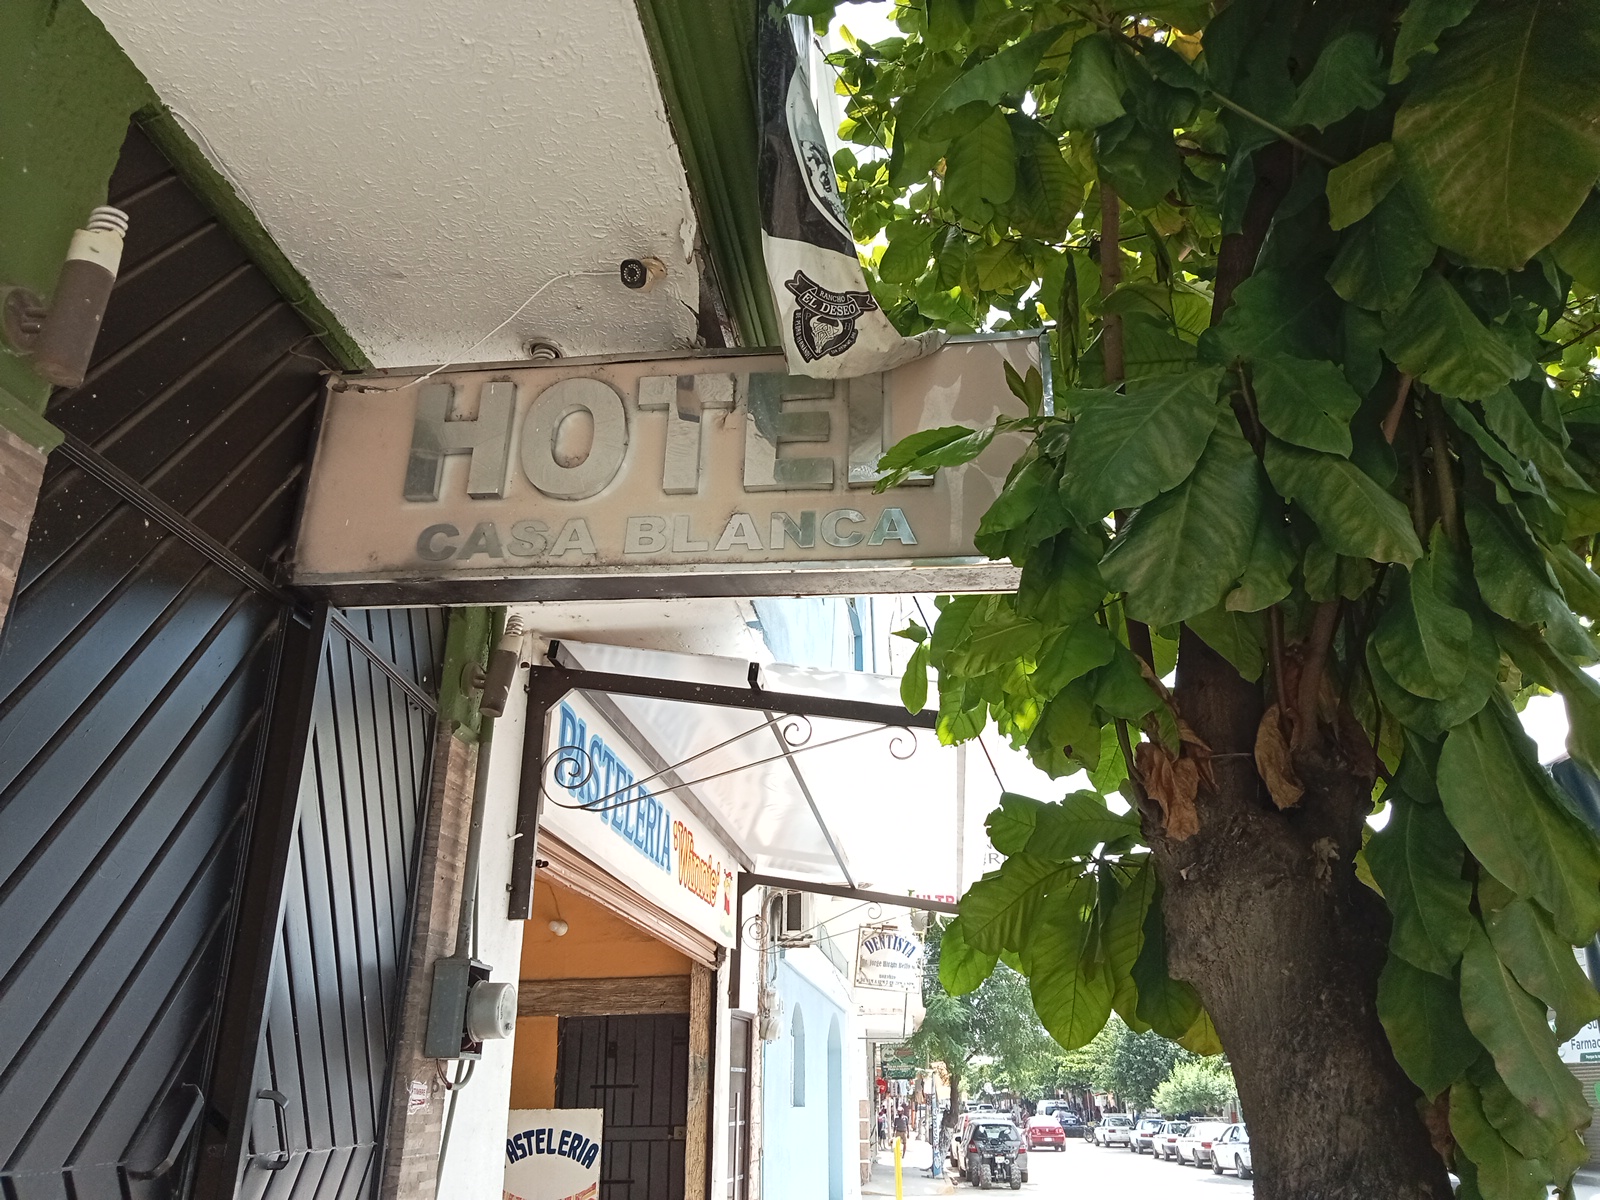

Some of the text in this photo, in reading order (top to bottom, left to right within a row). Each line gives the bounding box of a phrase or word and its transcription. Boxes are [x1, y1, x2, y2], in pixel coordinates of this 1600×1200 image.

[801, 293, 856, 317] EL DESEO
[820, 290, 845, 303] RANCHO
[403, 373, 936, 502] HOTEL
[416, 507, 918, 561] CASA BLANCA
[554, 701, 672, 875] PASTELERIA
[864, 933, 916, 958] DENTISTA
[506, 1128, 599, 1169] ASTELERIA
